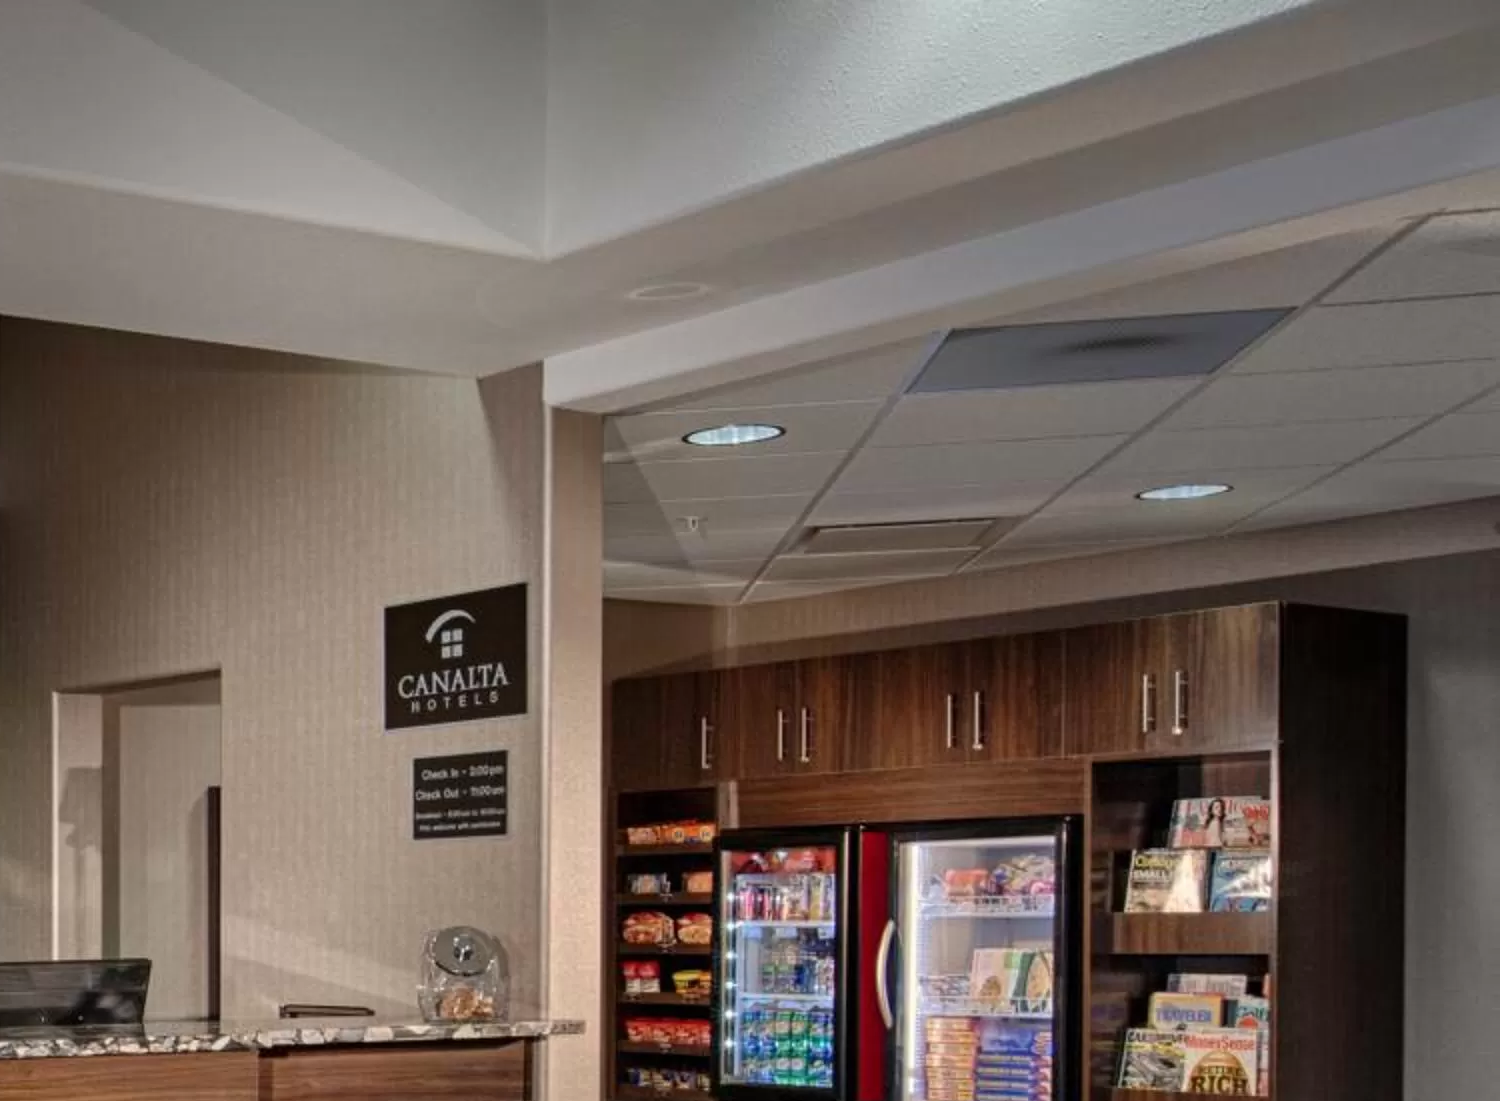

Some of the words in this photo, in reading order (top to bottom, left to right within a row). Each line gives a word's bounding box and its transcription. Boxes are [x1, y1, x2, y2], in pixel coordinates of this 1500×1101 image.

[398, 661, 510, 699] CANALTA
[411, 690, 499, 713] HOTELS
[421, 768, 448, 780] Check
[415, 789, 441, 800] Check
[443, 787, 459, 799] Out
[1190, 1075, 1249, 1095] RICH
